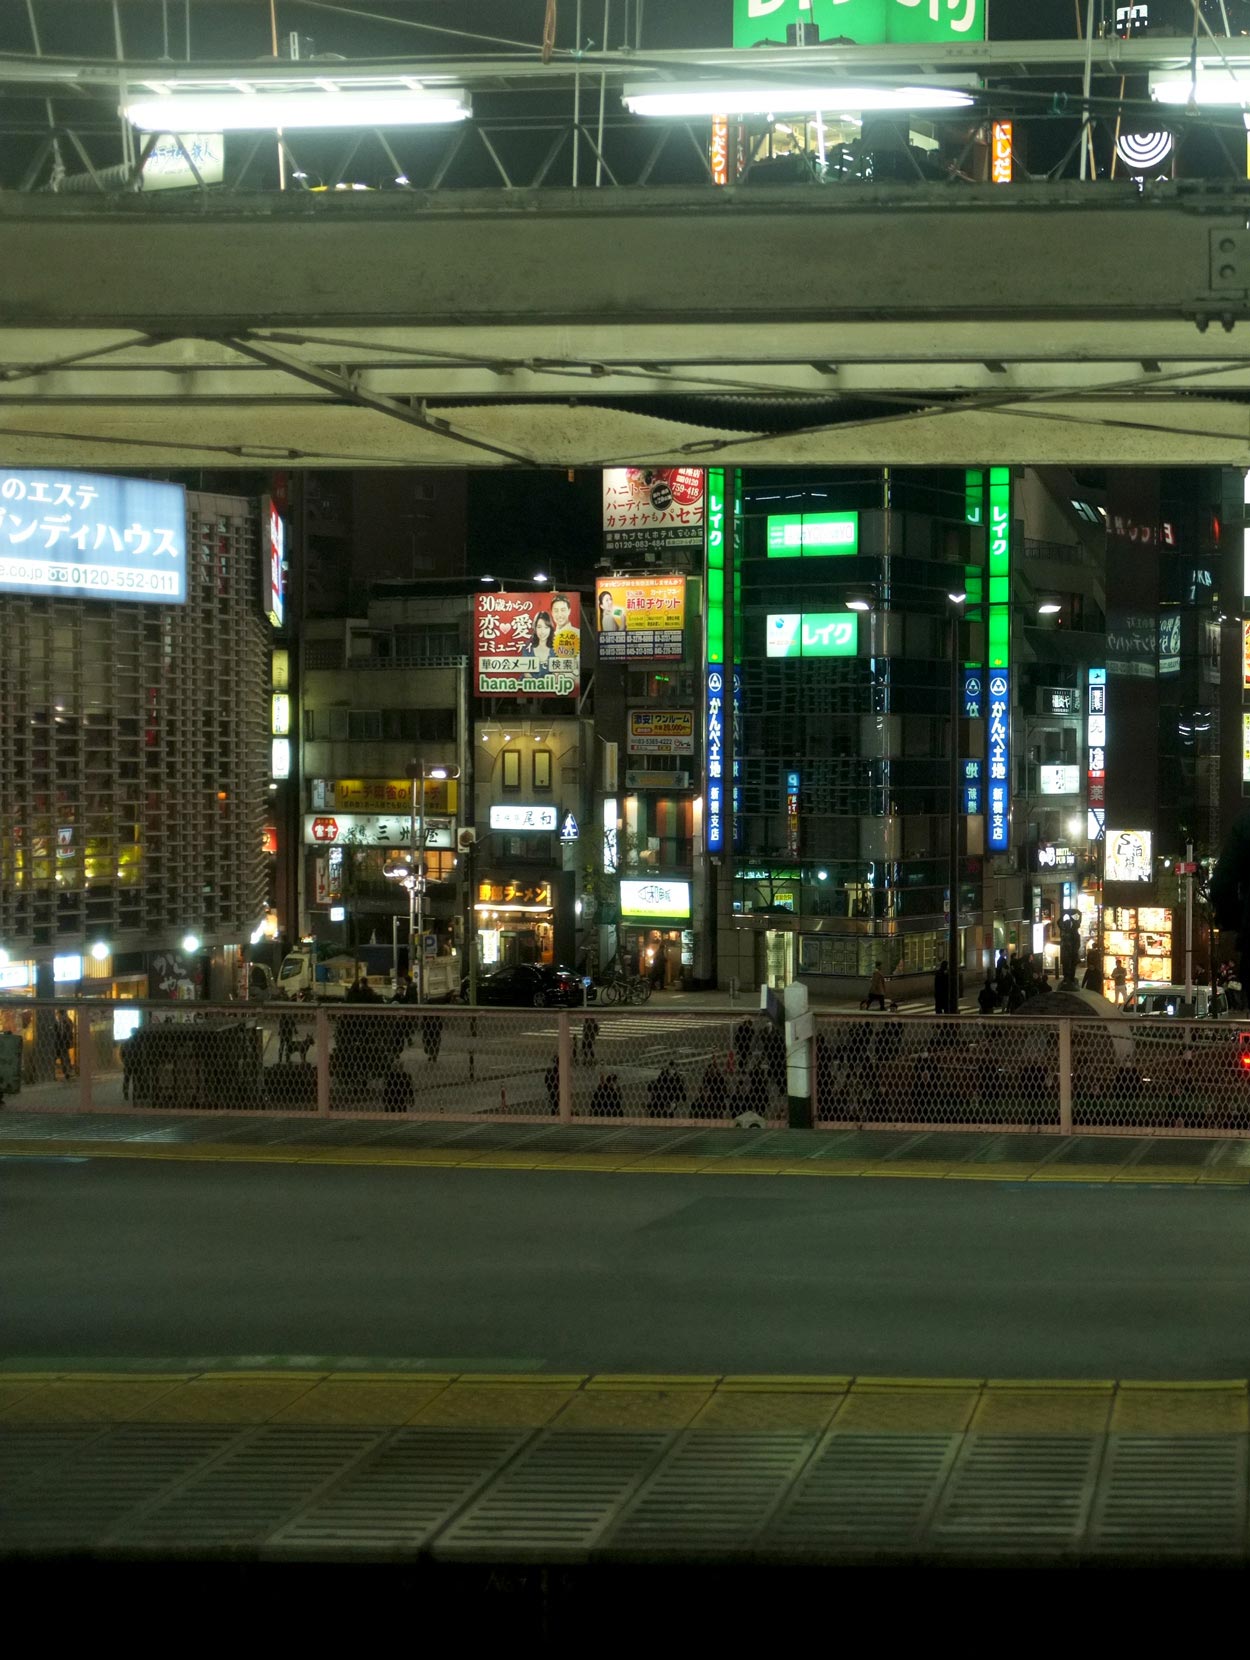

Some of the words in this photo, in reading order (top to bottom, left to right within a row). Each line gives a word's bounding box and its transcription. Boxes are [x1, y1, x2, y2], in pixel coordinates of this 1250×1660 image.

[995, 124, 1011, 183] にしだ
[606, 484, 650, 497] ハニトー
[672, 483, 700, 497] 759-418
[606, 499, 650, 512] パーティー
[710, 496, 722, 546] レイク
[992, 506, 1007, 556] レイク
[71, 570, 174, 591] 0120-552-011
[479, 595, 533, 613] 30歳からの
[802, 623, 853, 645] レイク
[479, 641, 533, 654] コミュニティ
[480, 674, 575, 695] hana-mail.jp
[708, 698, 722, 778] かんべ土地
[991, 701, 1006, 779] かんべ土地
[1090, 785, 1104, 801] 薬
[710, 787, 720, 841] 新橋支店
[993, 788, 1004, 841] 新橋支店
